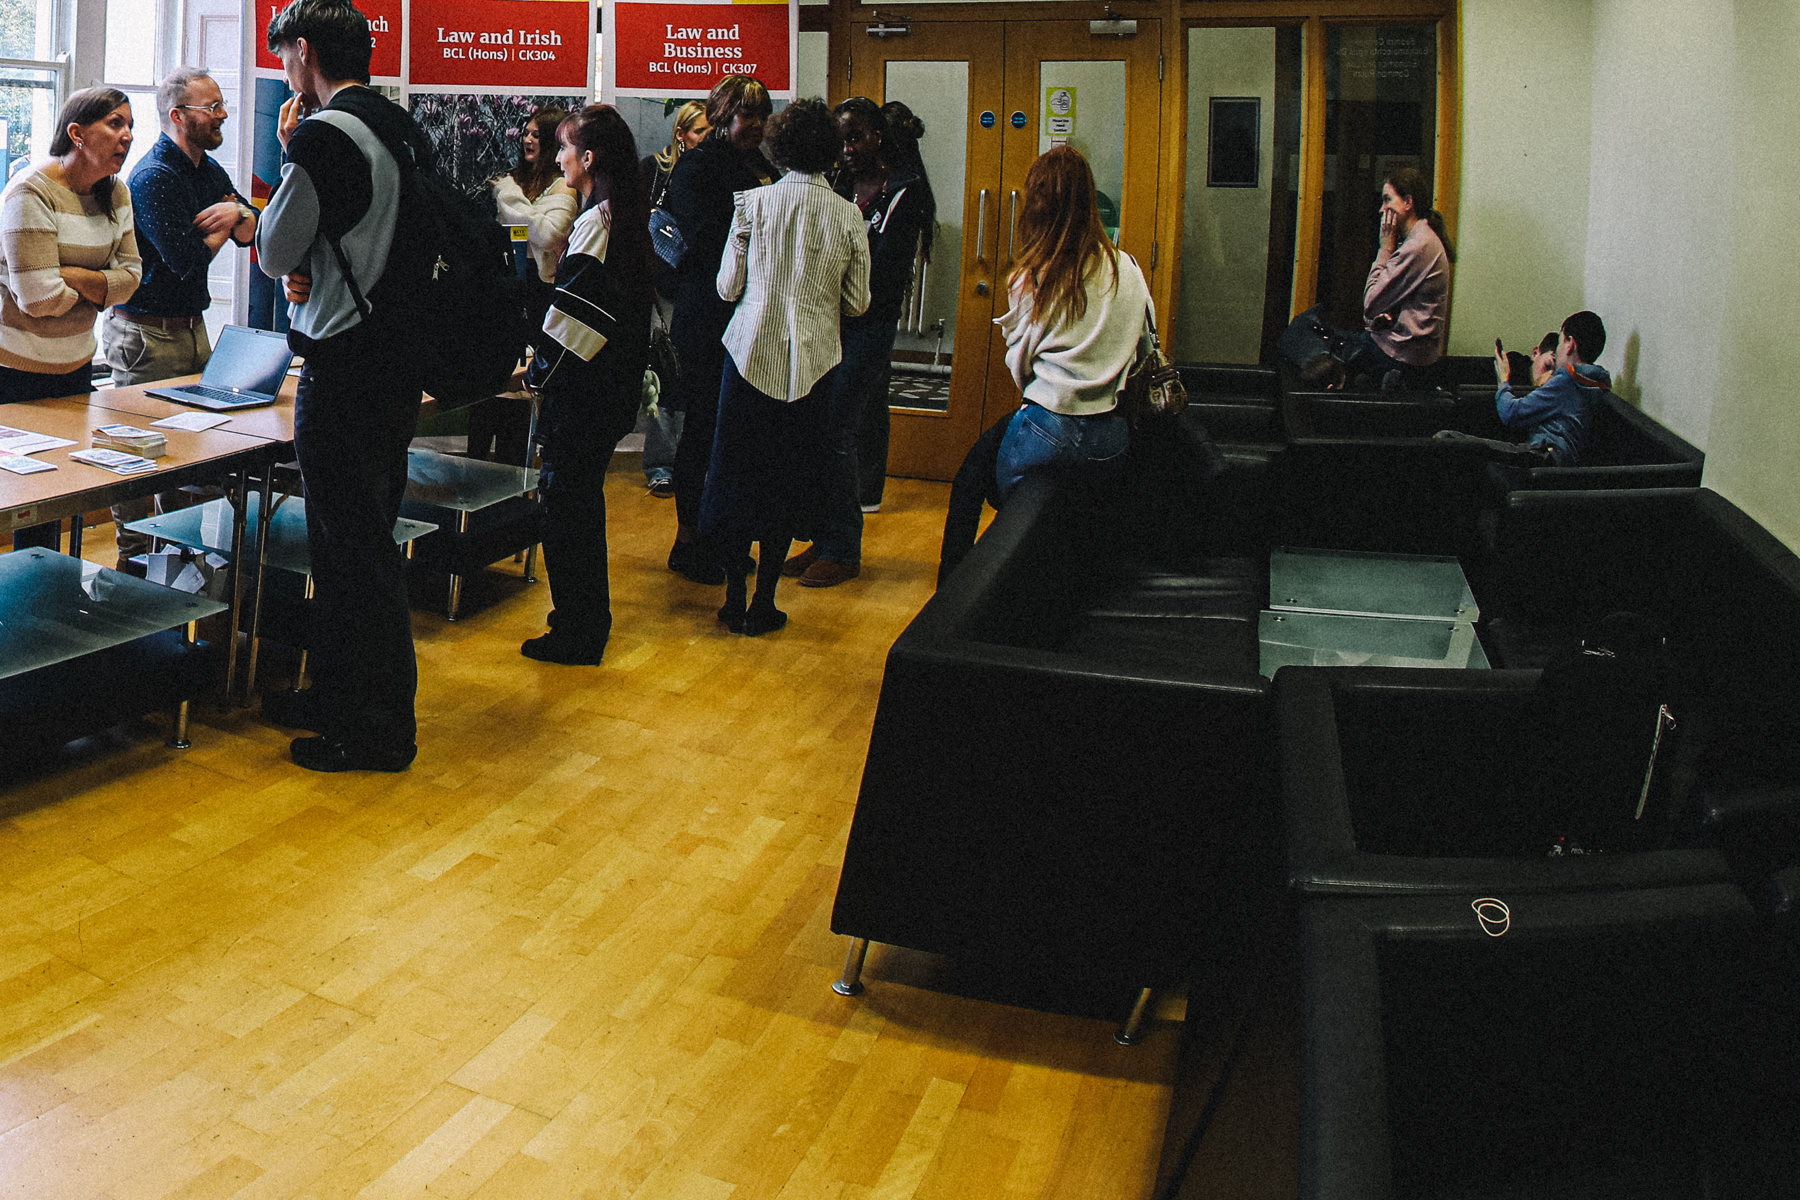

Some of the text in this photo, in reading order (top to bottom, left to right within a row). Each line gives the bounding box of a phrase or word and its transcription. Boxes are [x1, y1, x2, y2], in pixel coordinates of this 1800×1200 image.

[437, 27, 562, 46] Law and Irish
[665, 23, 740, 40] Law and
[443, 47, 466, 59] BCL
[468, 46, 508, 61] (Hons)
[518, 49, 556, 61] CK304
[663, 42, 743, 59] Business
[649, 61, 671, 73] BCL
[673, 60, 712, 75] (Hons)
[721, 63, 758, 74] CK307
